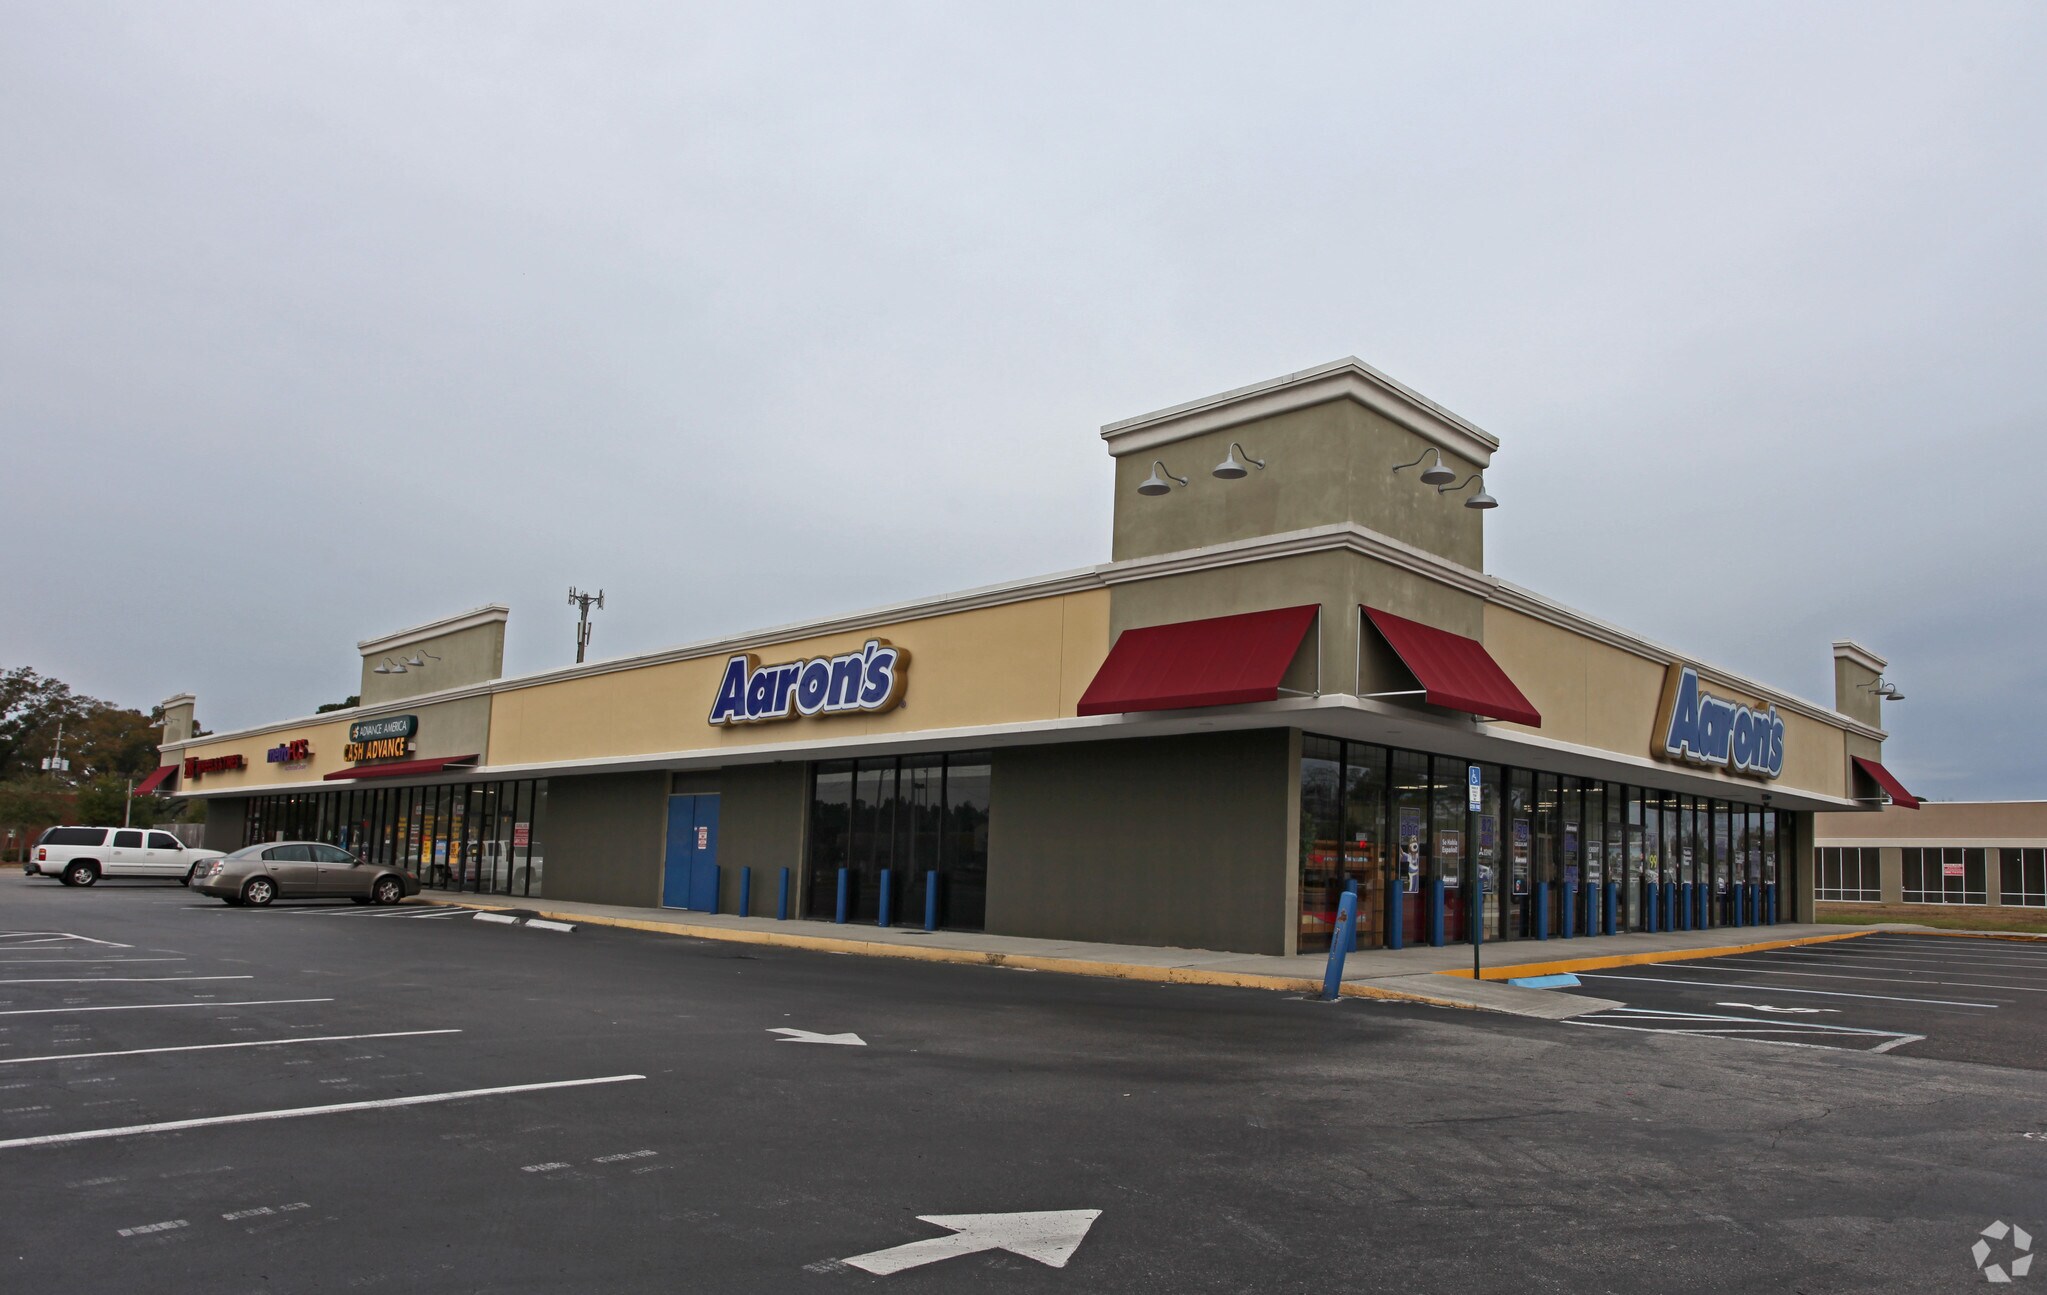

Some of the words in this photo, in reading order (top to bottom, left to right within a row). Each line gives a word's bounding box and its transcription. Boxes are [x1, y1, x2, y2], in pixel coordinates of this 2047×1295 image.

[710, 641, 896, 723] Aaron's
[359, 723, 383, 737] ADVANCE
[383, 720, 407, 733] AMERICA
[1666, 667, 1784, 777] Aaron's
[344, 742, 364, 762] CASH
[366, 737, 405, 759] ADVANCE
